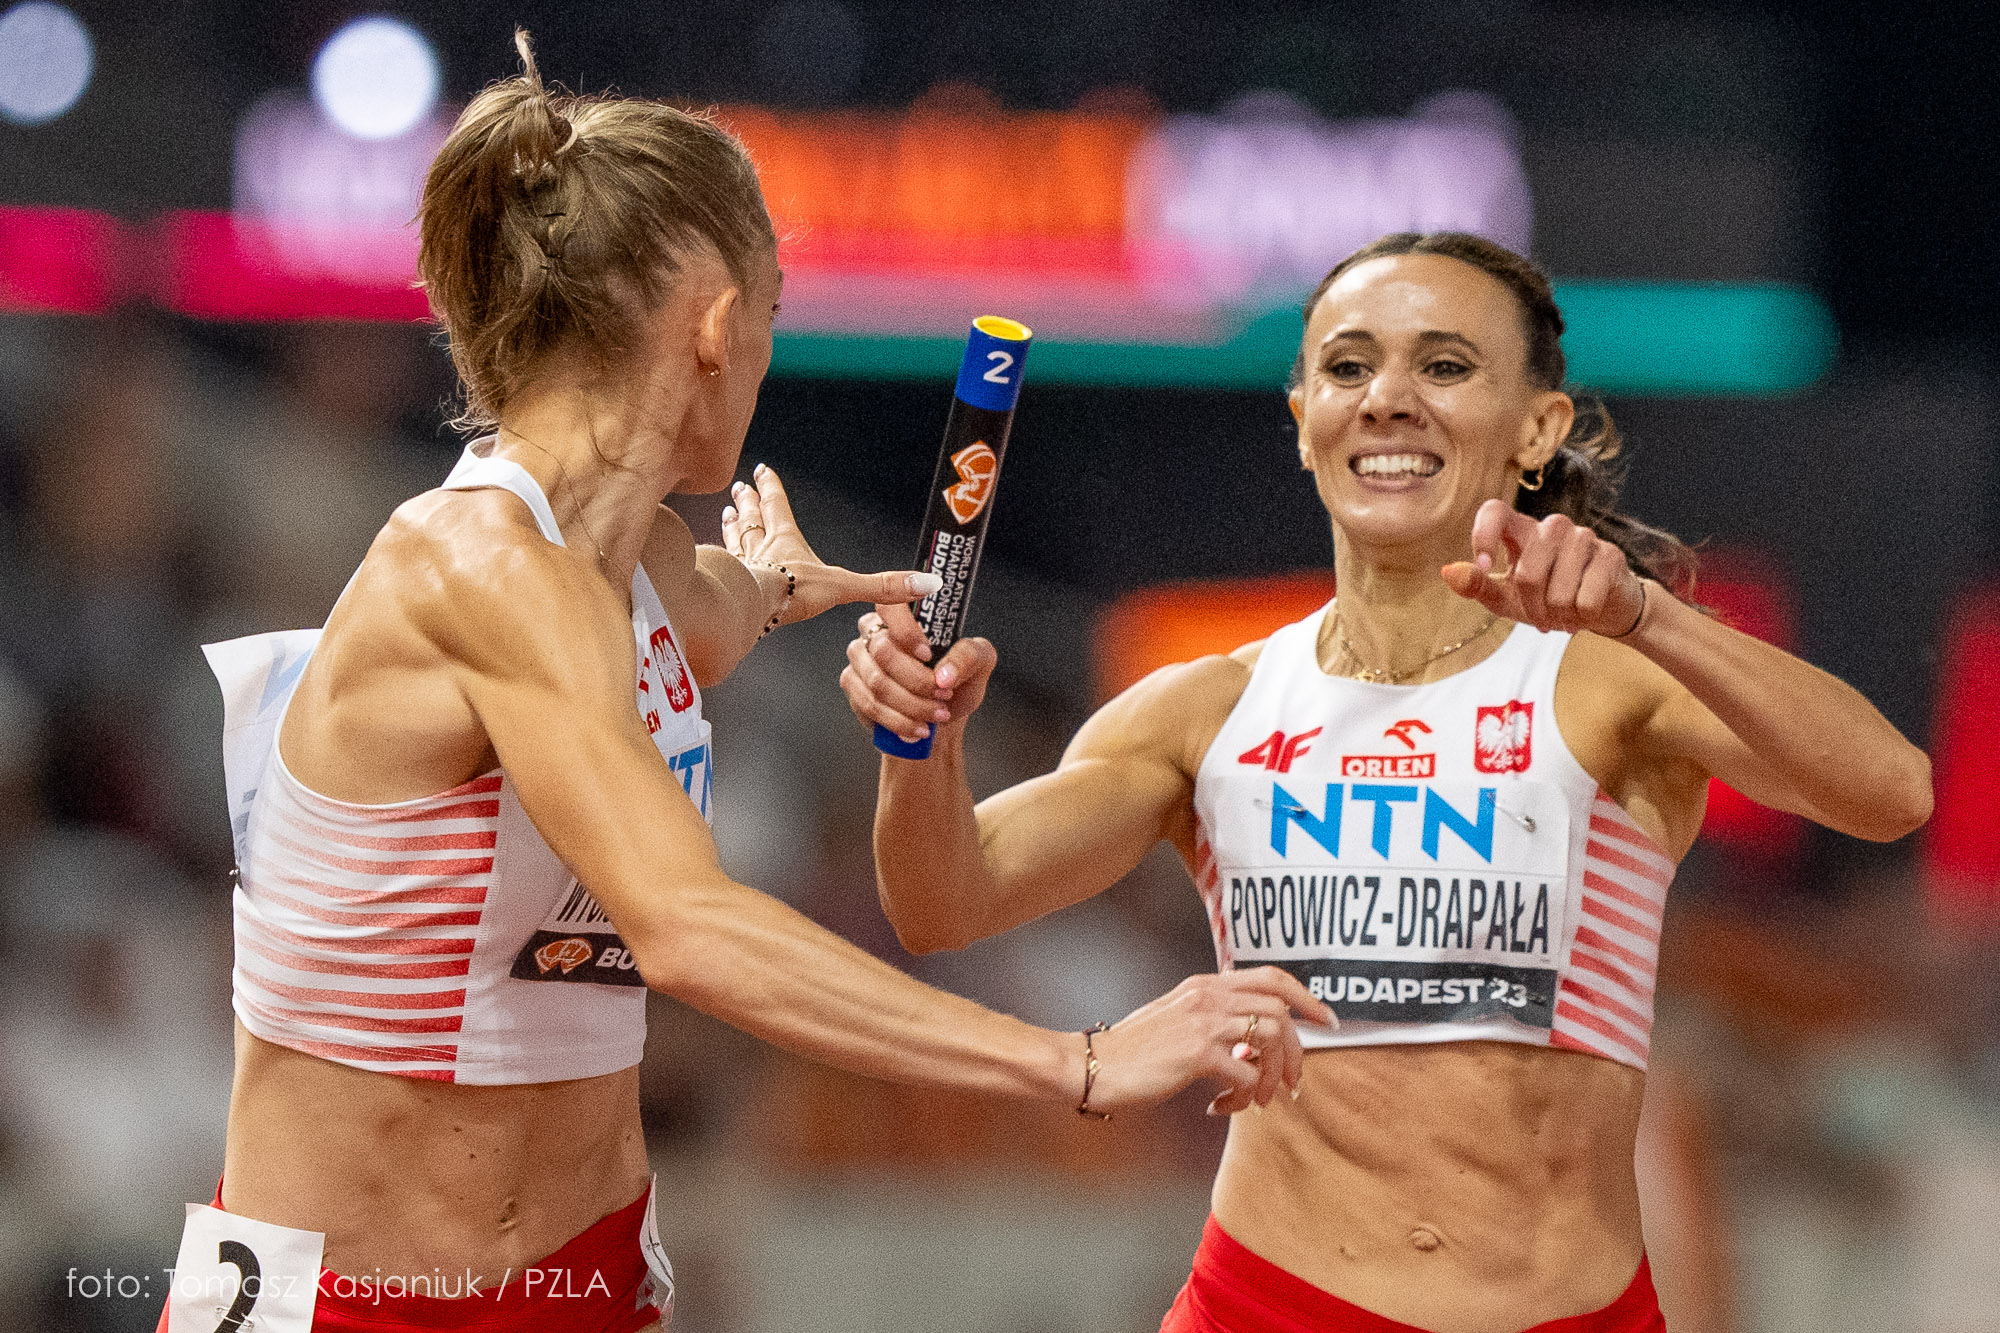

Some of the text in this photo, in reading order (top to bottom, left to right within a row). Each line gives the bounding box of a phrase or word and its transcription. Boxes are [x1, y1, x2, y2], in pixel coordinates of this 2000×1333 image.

[982, 350, 1015, 384] 2
[919, 531, 952, 623] BUDAEST
[930, 534, 965, 647] CHAMPIONSHIPS
[940, 535, 977, 648] WORLD ATHLETICS
[1238, 726, 1323, 774] 4F
[1345, 757, 1431, 778] ORLEN
[1270, 781, 1497, 863] NTN
[1231, 874, 1550, 954] POPOWICZ-DRAPAŁA
[1308, 976, 1486, 1005] BUDAPEST
